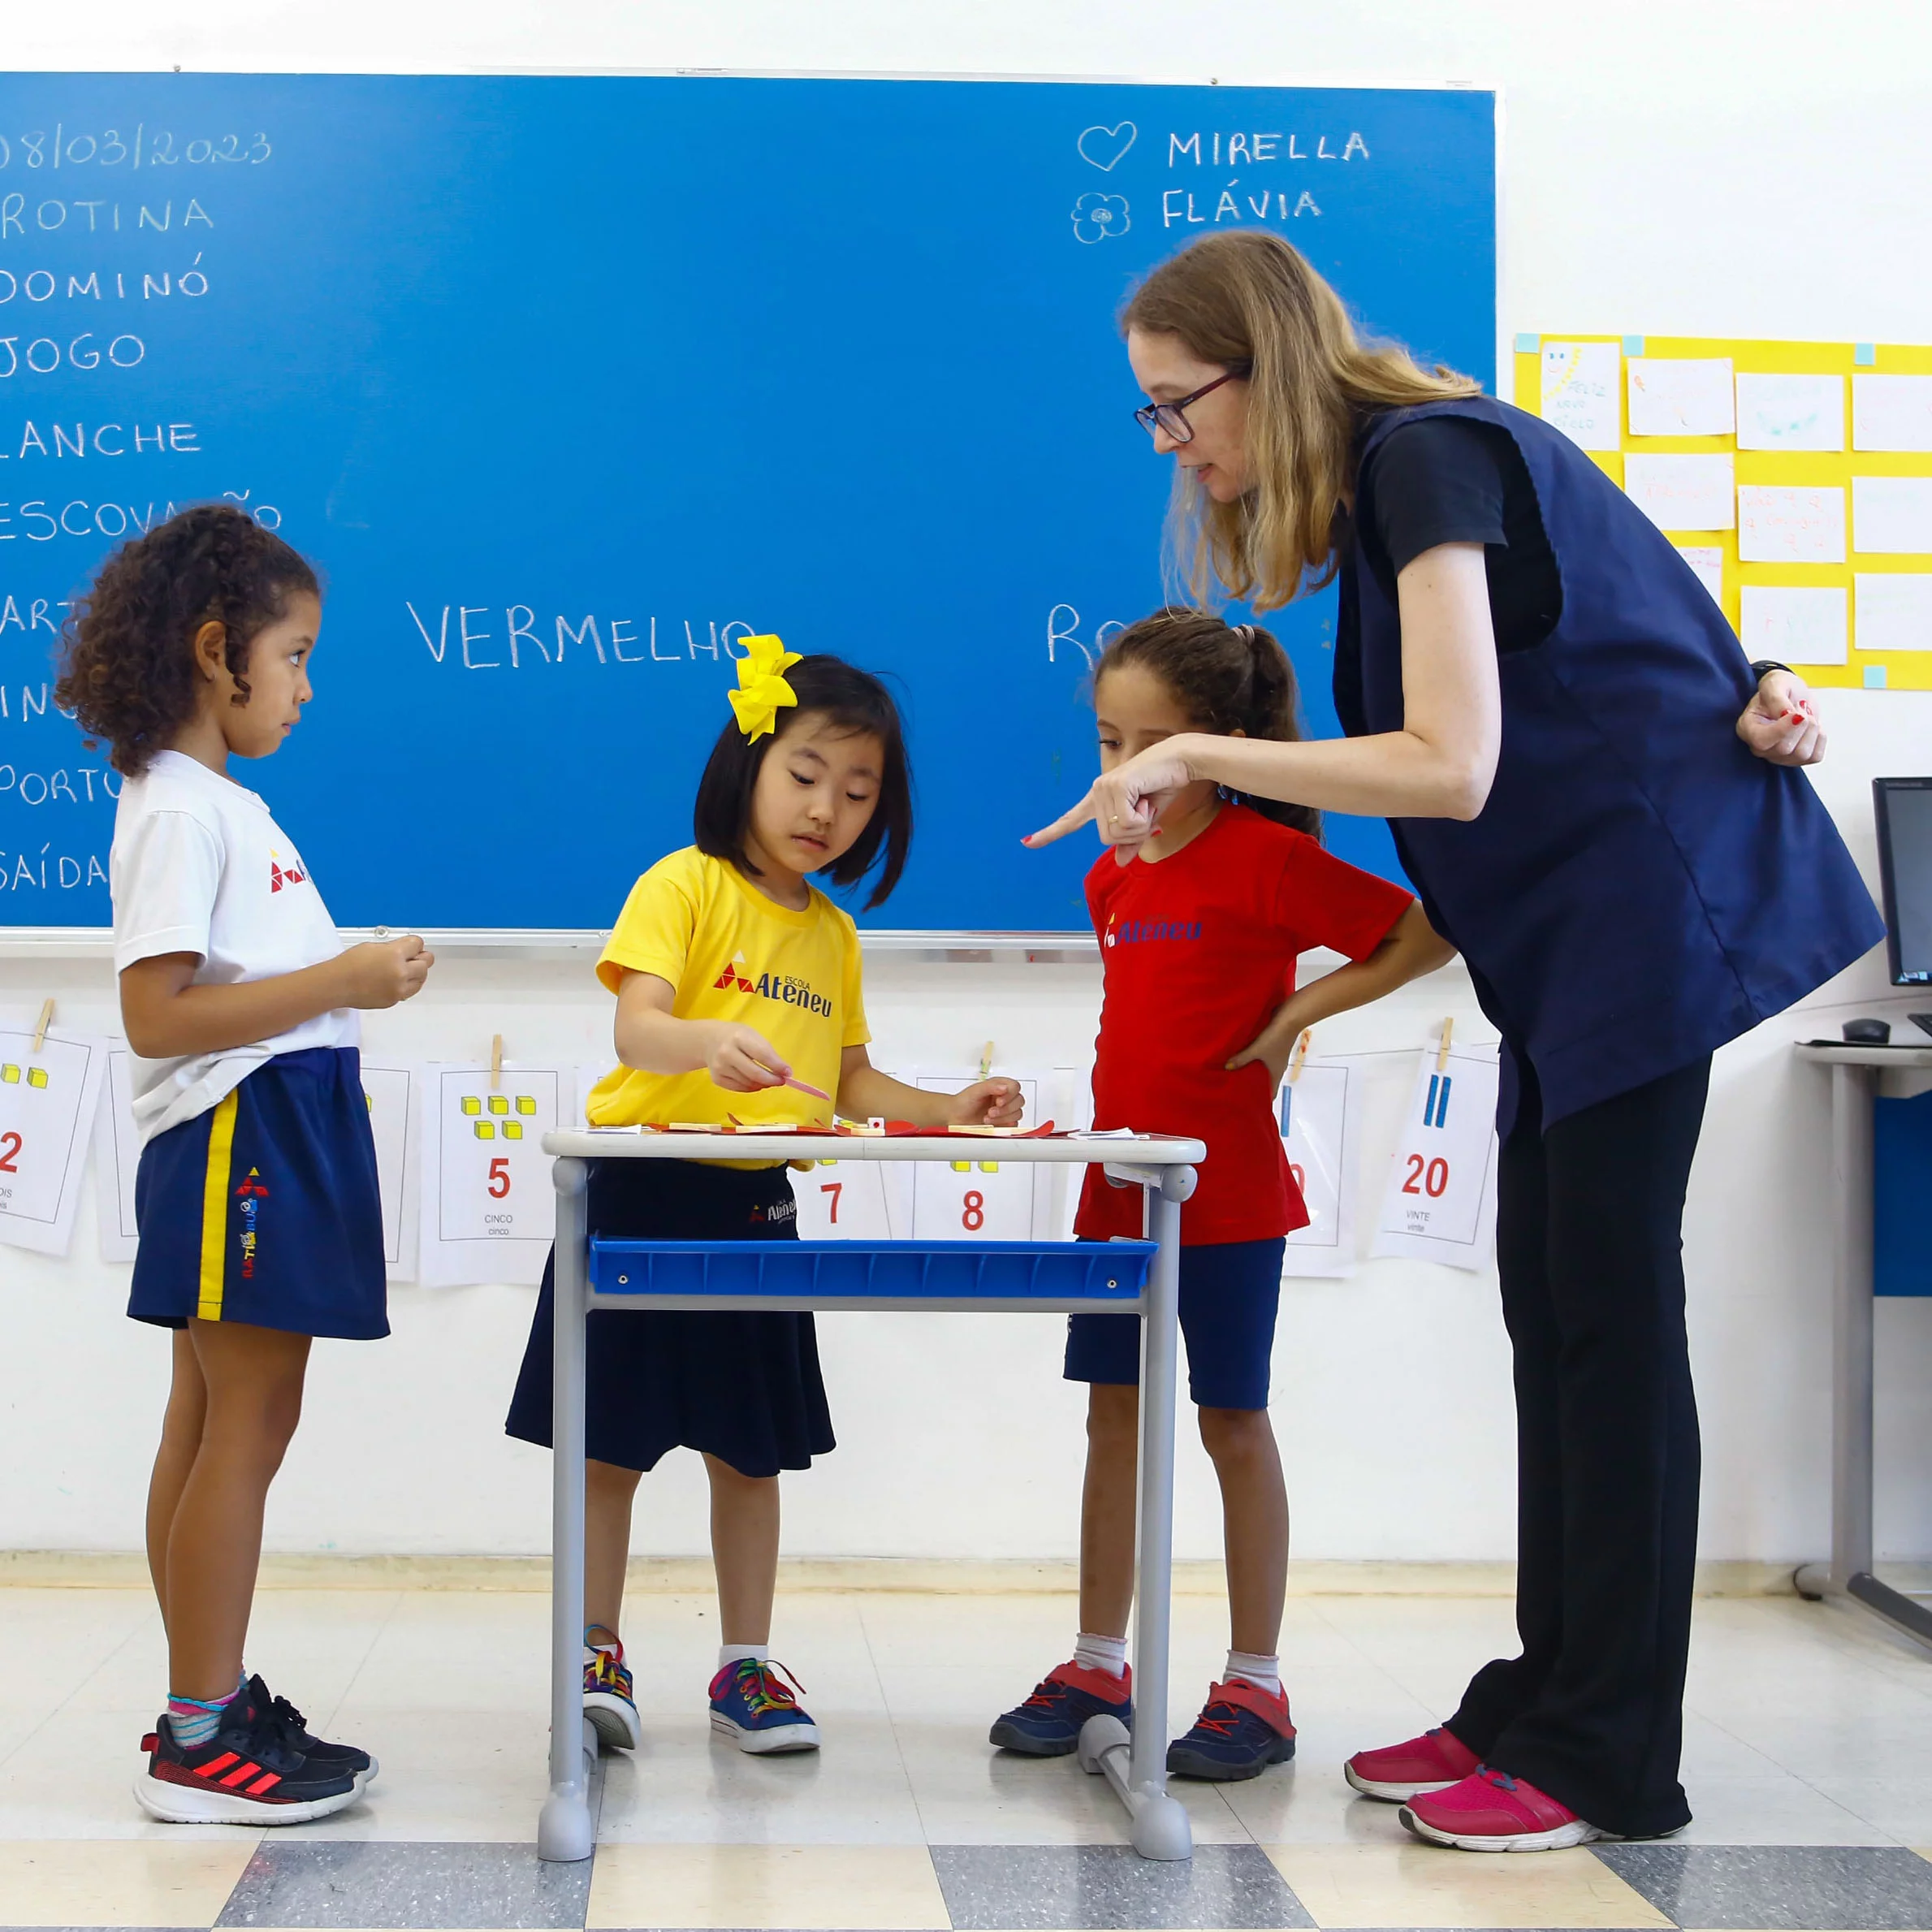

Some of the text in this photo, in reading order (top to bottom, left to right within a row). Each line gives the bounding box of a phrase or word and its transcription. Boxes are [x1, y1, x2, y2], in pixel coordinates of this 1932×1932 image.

[1169, 132, 1370, 167] MIRELLA
[2, 193, 214, 239] ROTINA
[1163, 179, 1322, 228] FLÁVIA
[0, 420, 201, 460] ANCHE
[406, 601, 756, 669] VERMELHO
[1116, 919, 1202, 945] Ateneu
[754, 972, 832, 1018] Ateneu
[784, 975, 810, 990] ESCOLA
[0, 1131, 23, 1173] 2
[488, 1158, 511, 1199] 5
[1402, 1153, 1449, 1198] 20
[484, 1214, 512, 1223] CINCO
[820, 1182, 842, 1224] 7
[962, 1190, 984, 1231] 8
